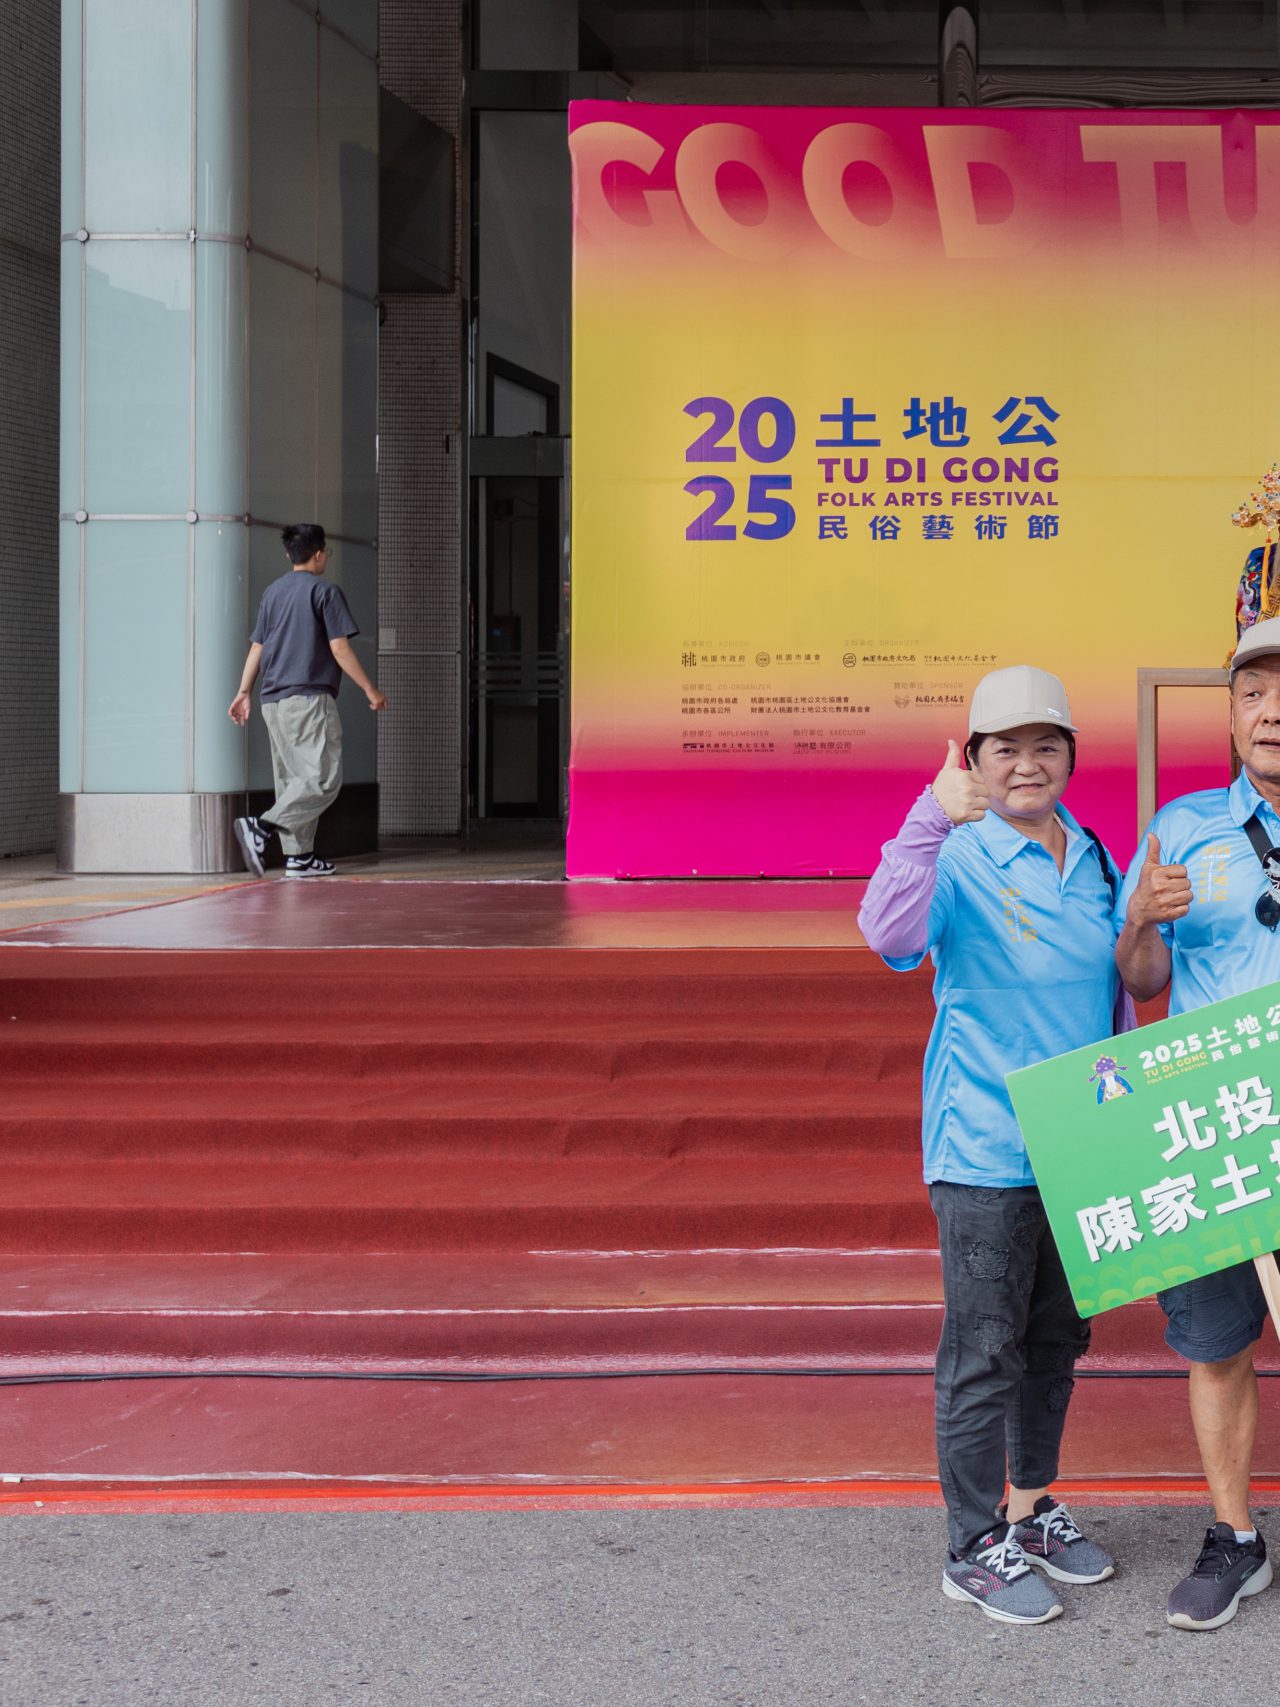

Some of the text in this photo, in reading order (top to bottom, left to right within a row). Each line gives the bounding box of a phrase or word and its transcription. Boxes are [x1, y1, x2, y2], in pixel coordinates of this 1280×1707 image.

[569, 121, 1036, 261] GOOD
[683, 396, 796, 463] 20
[815, 396, 1061, 448] 土地公
[817, 456, 1060, 484] TU DI GONG
[683, 473, 796, 541] 25
[817, 491, 1059, 507] FOLK ARTS FESTIVAL
[817, 514, 1060, 541] 民俗藝術節
[1144, 1051, 1207, 1079] TU DI GONG
[1153, 1075, 1280, 1163] 北投
